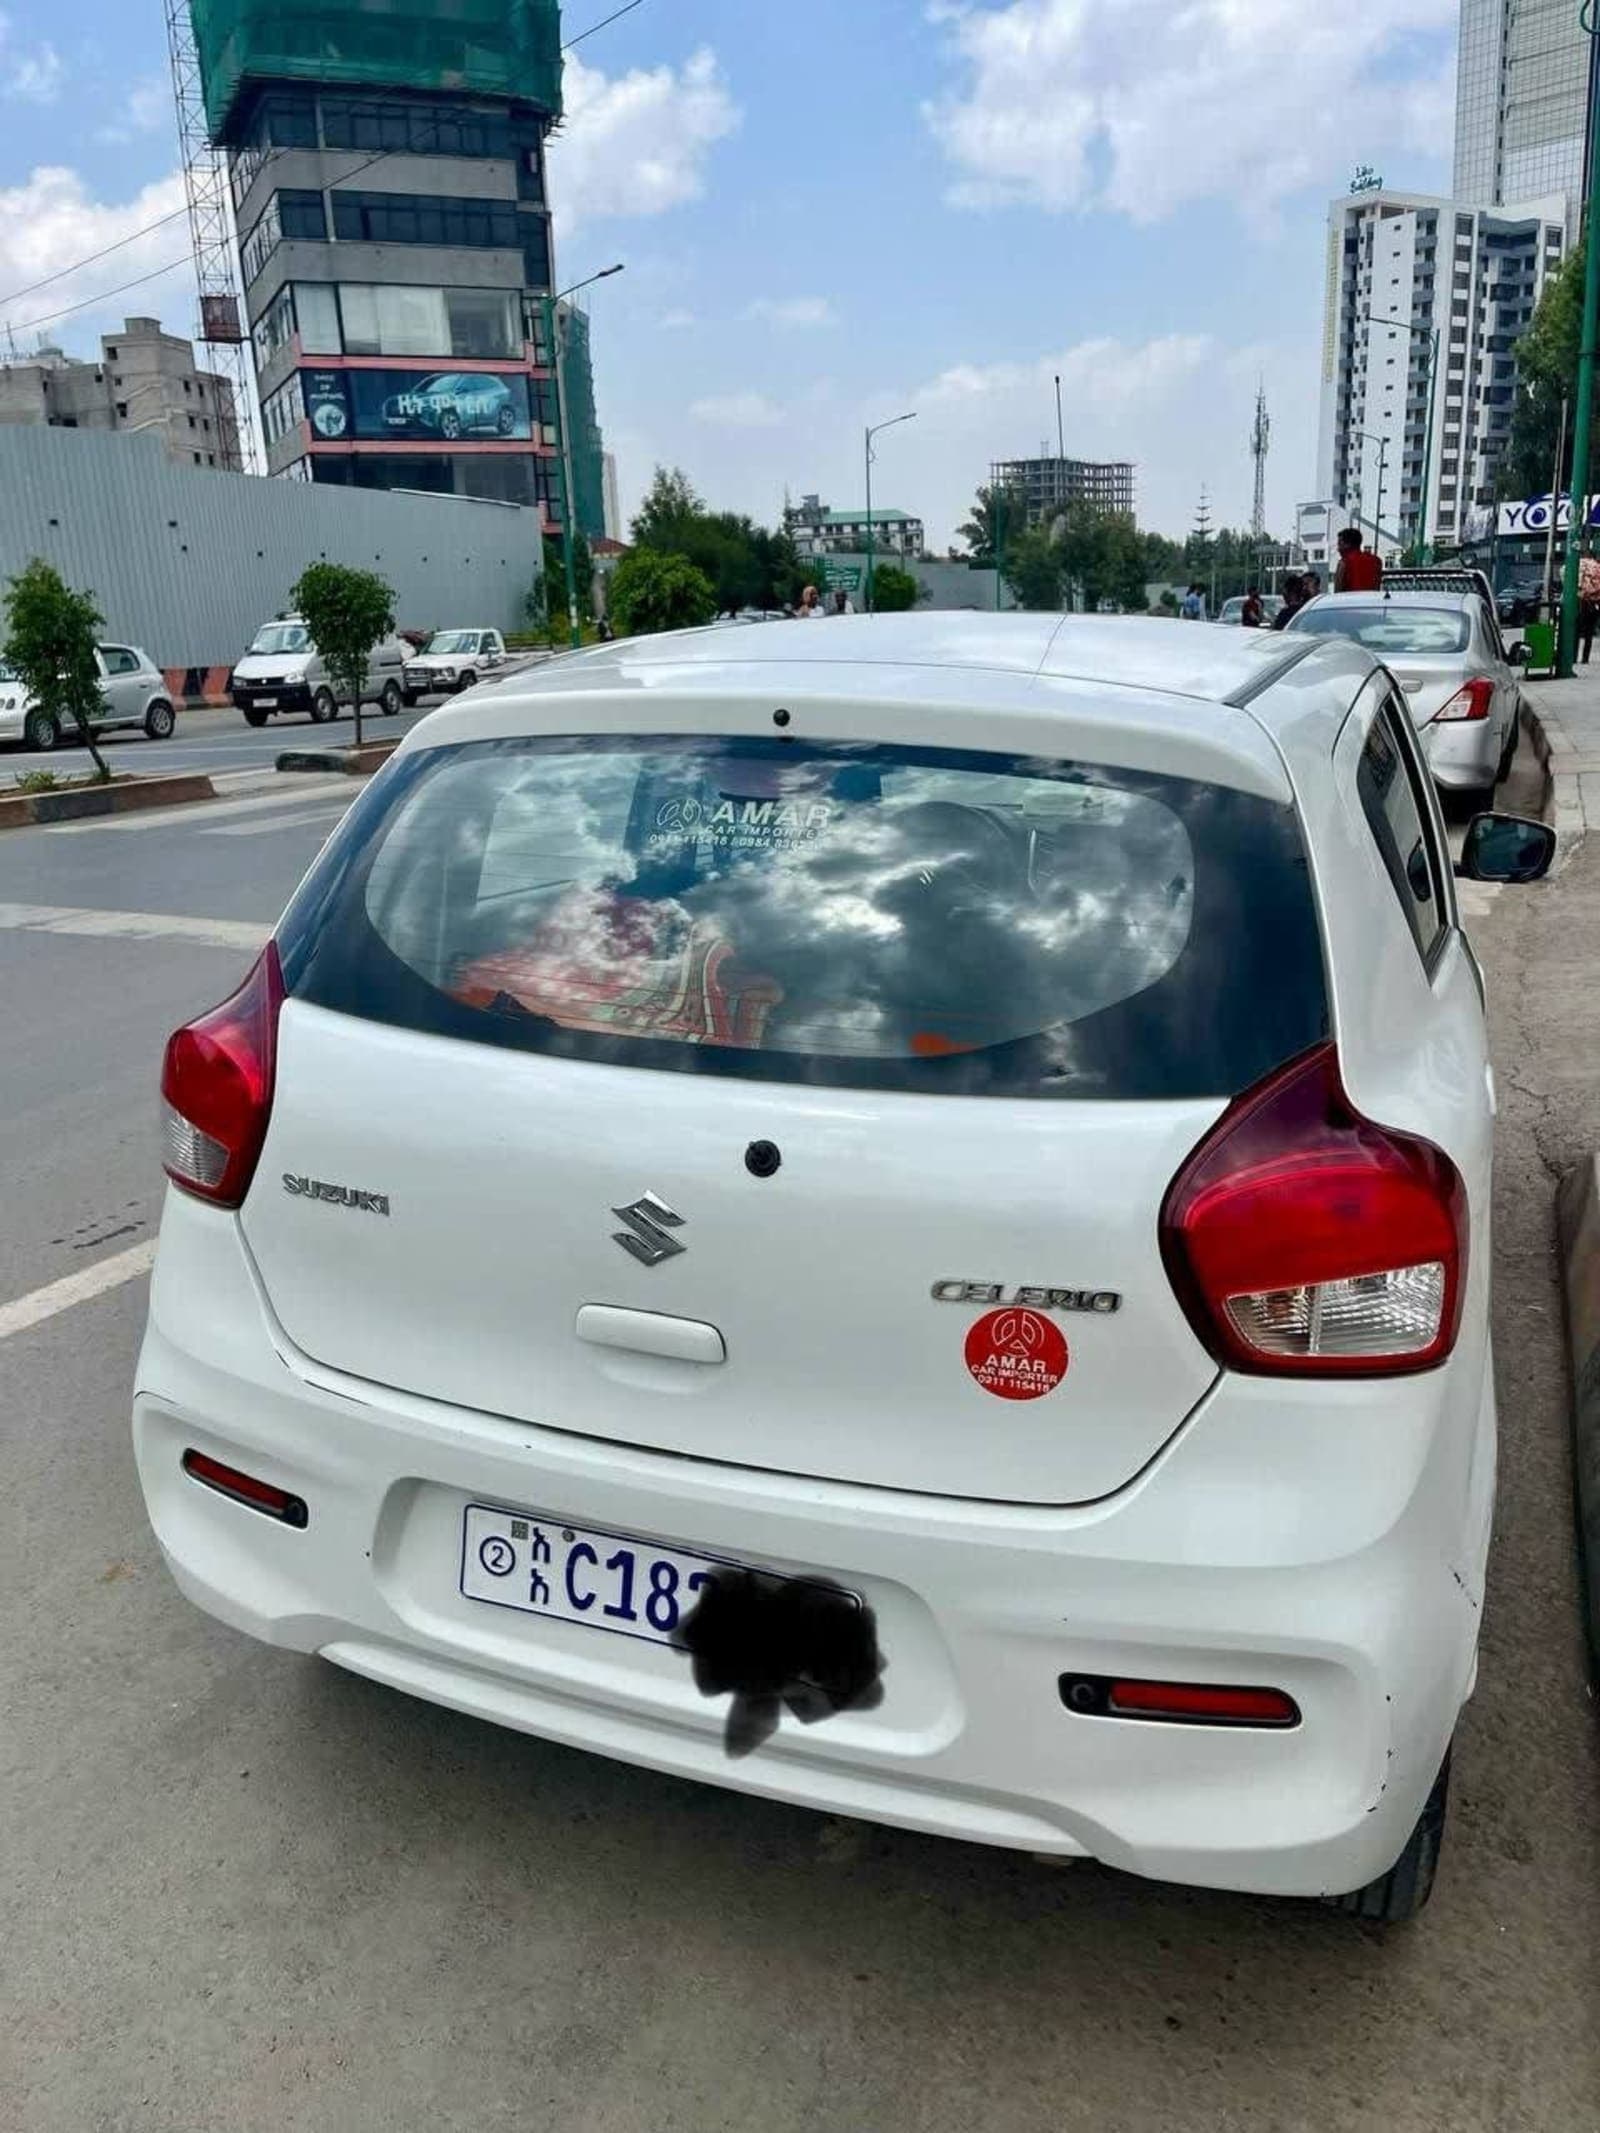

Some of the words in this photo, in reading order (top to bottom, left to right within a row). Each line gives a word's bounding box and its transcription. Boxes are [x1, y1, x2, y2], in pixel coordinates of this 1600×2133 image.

[711, 800, 832, 828] AMAR
[704, 825, 736, 836] CAR
[282, 1172, 390, 1217] SUZUKI
[931, 1278, 1123, 1314] CELERIO
[971, 1363, 997, 1375] CAR
[998, 1367, 1058, 1385] IMPORTER
[985, 1353, 1047, 1374] AMAR
[490, 1545, 505, 1568] 2
[565, 1542, 716, 1632] C18
